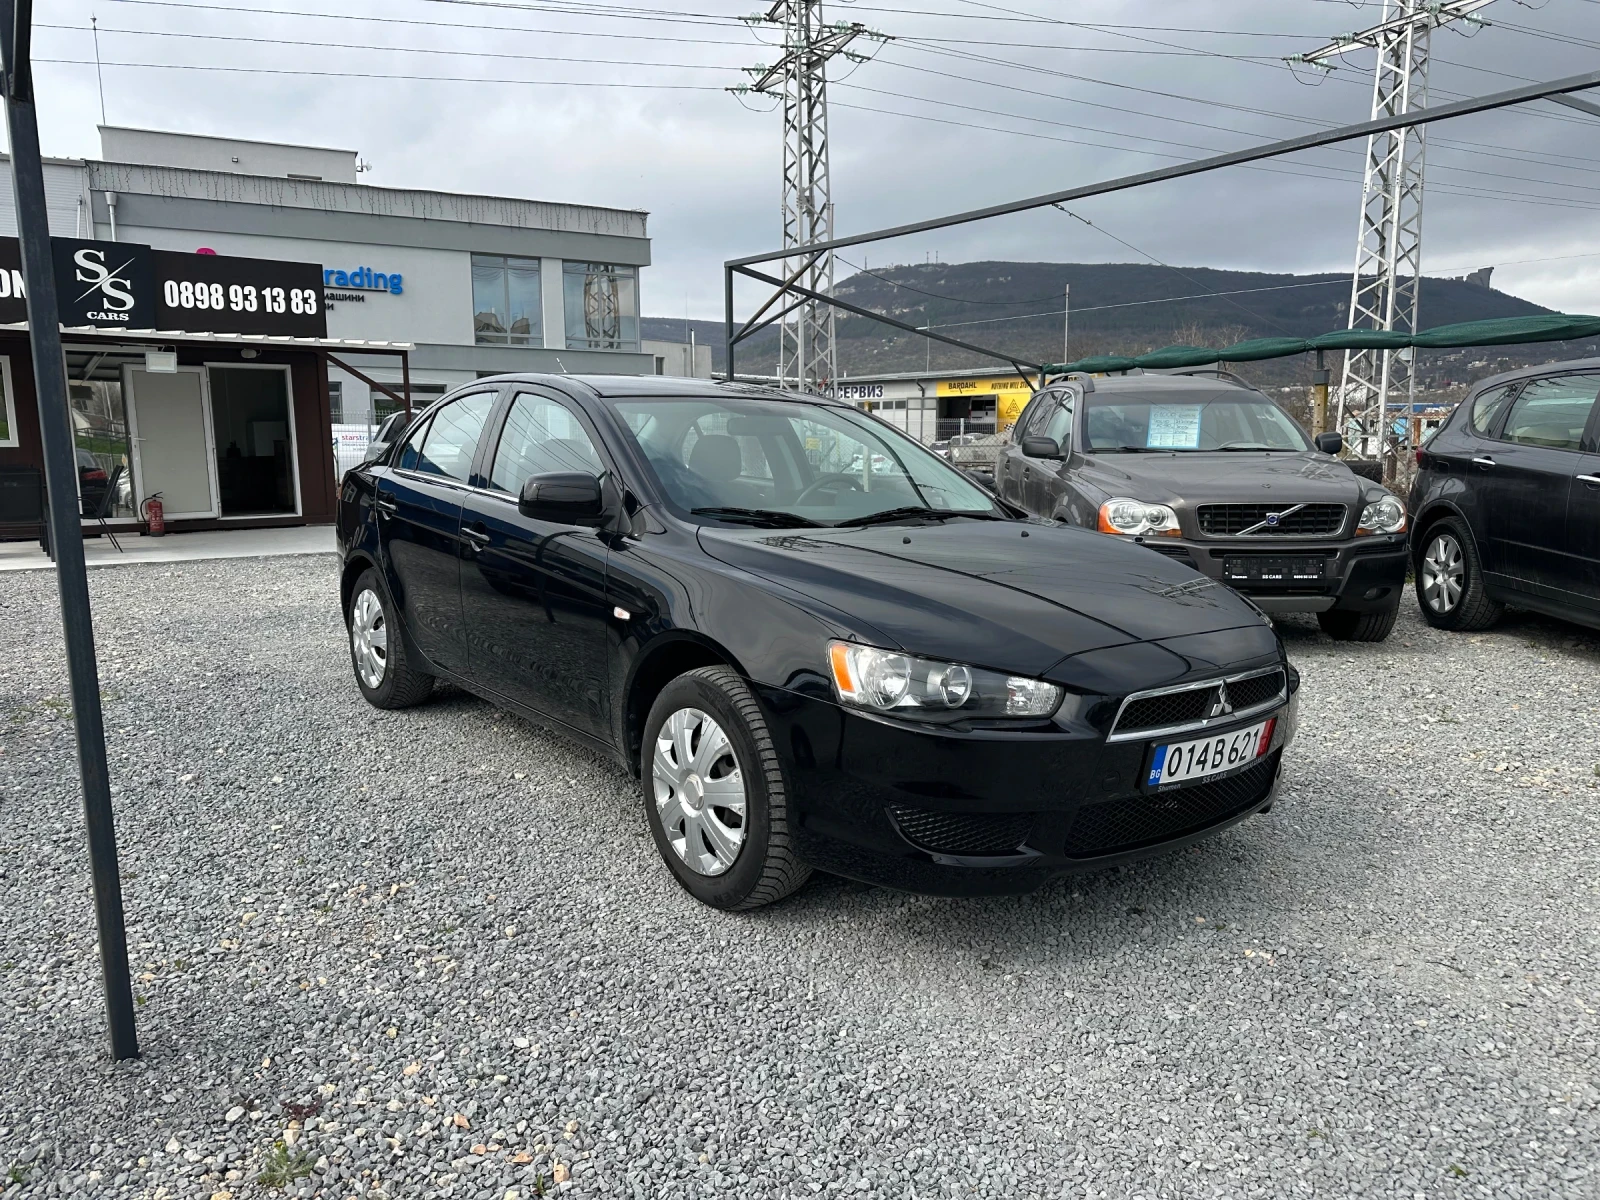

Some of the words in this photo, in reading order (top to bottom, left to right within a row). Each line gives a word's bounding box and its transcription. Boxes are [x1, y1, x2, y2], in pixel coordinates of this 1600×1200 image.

[163, 279, 225, 311] 0898
[228, 284, 258, 312] 93
[261, 287, 286, 314] 13
[290, 288, 318, 315] 83
[86, 311, 130, 321] CARS
[948, 381, 978, 391] BARDAHL
[1149, 769, 1161, 780] BG
